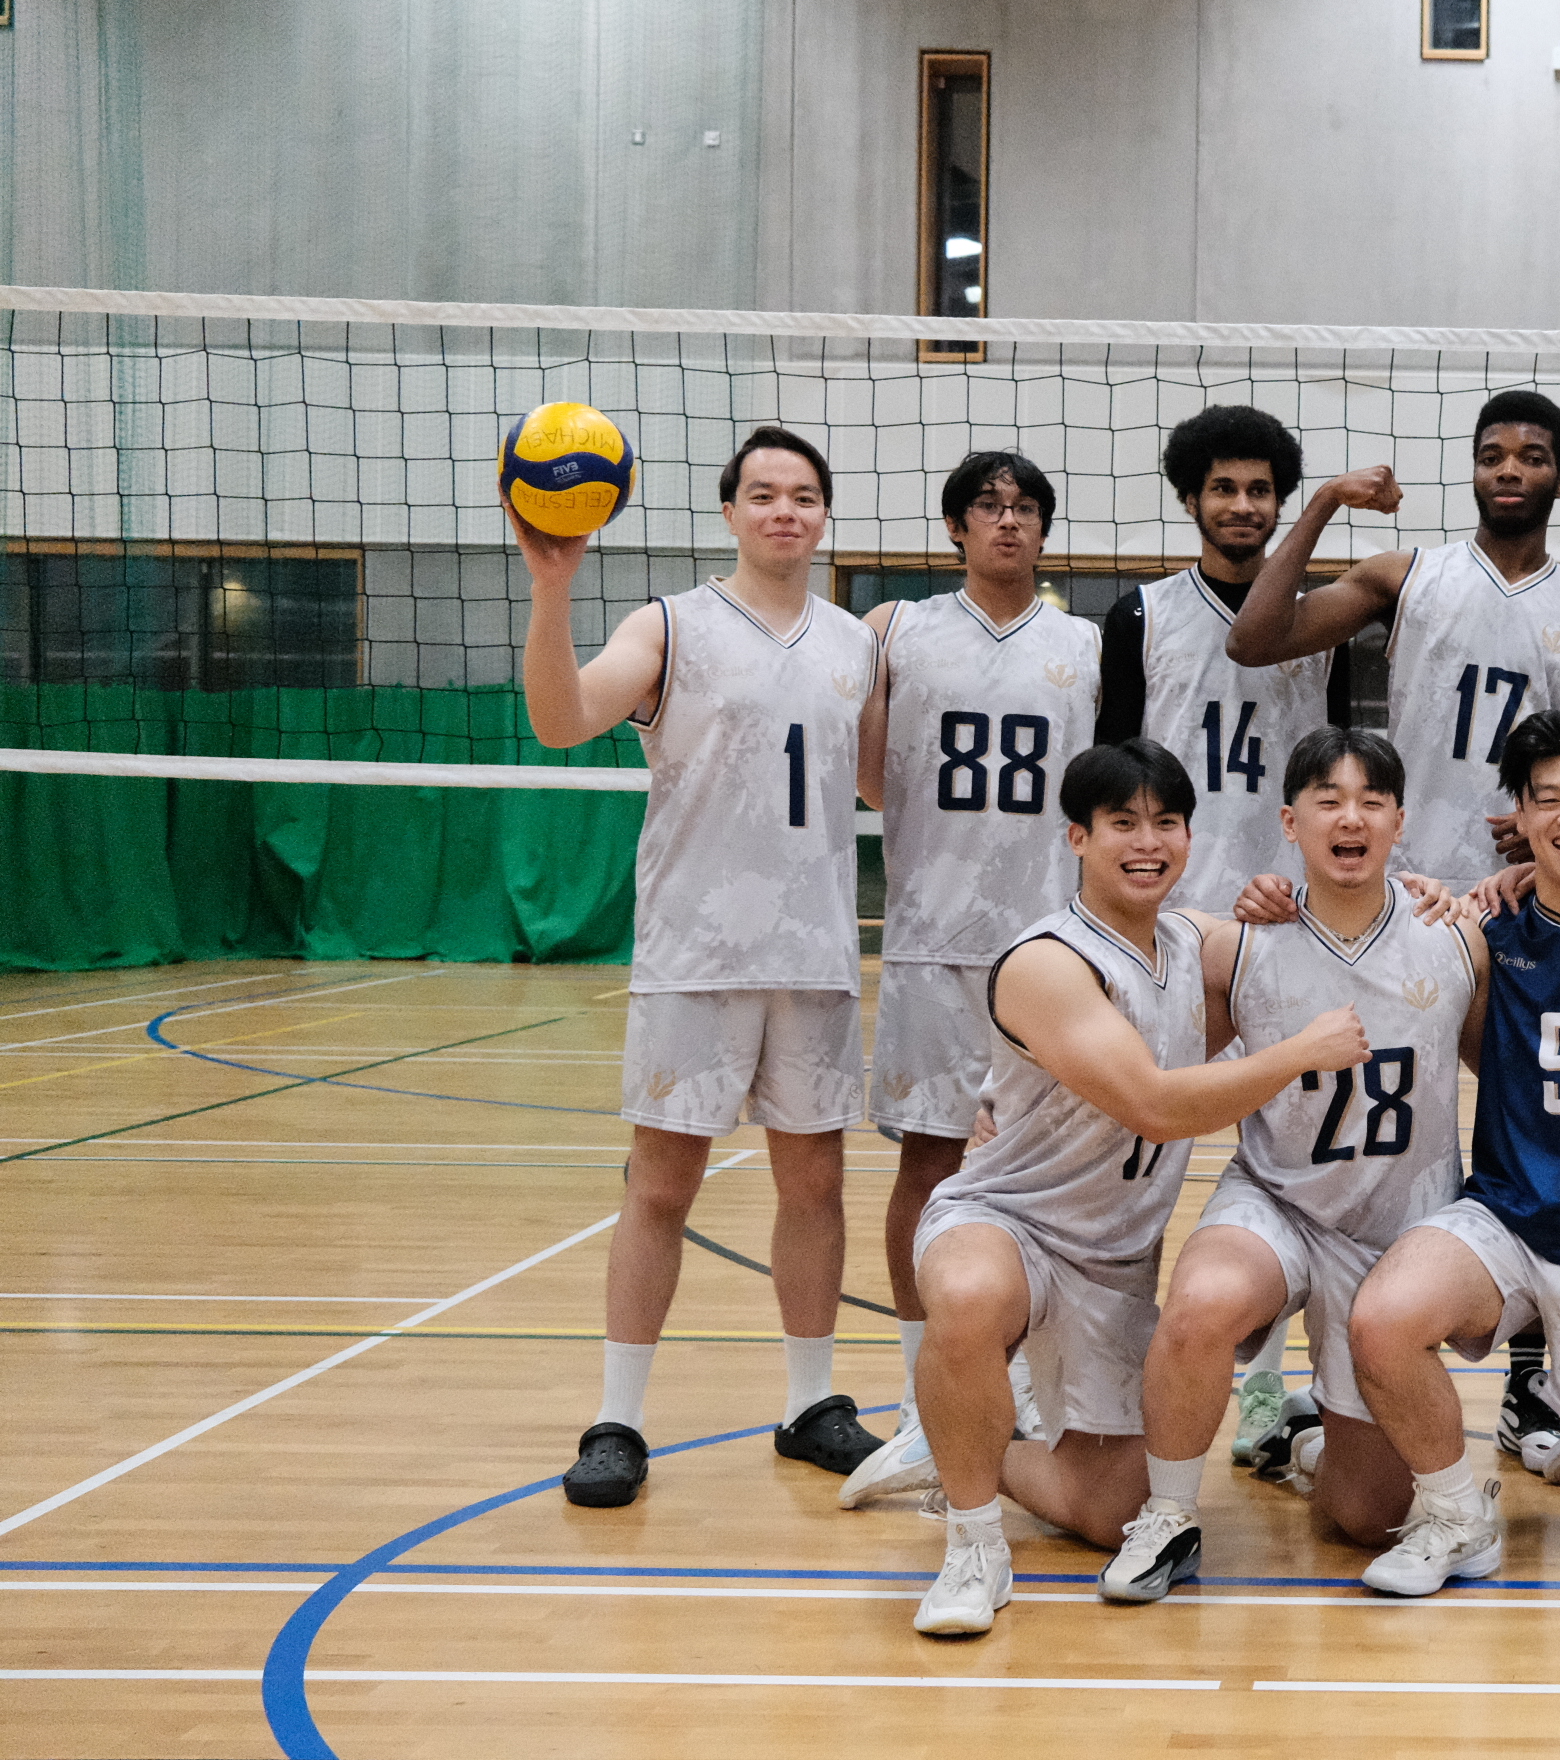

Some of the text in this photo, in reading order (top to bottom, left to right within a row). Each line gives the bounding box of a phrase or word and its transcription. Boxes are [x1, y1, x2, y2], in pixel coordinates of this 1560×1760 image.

[523, 427, 616, 452] MICHAEL
[937, 711, 1051, 815] 88
[1201, 700, 1265, 793] 14
[1453, 664, 1530, 764] 17
[784, 724, 808, 828] 1
[1300, 1046, 1416, 1165] 28
